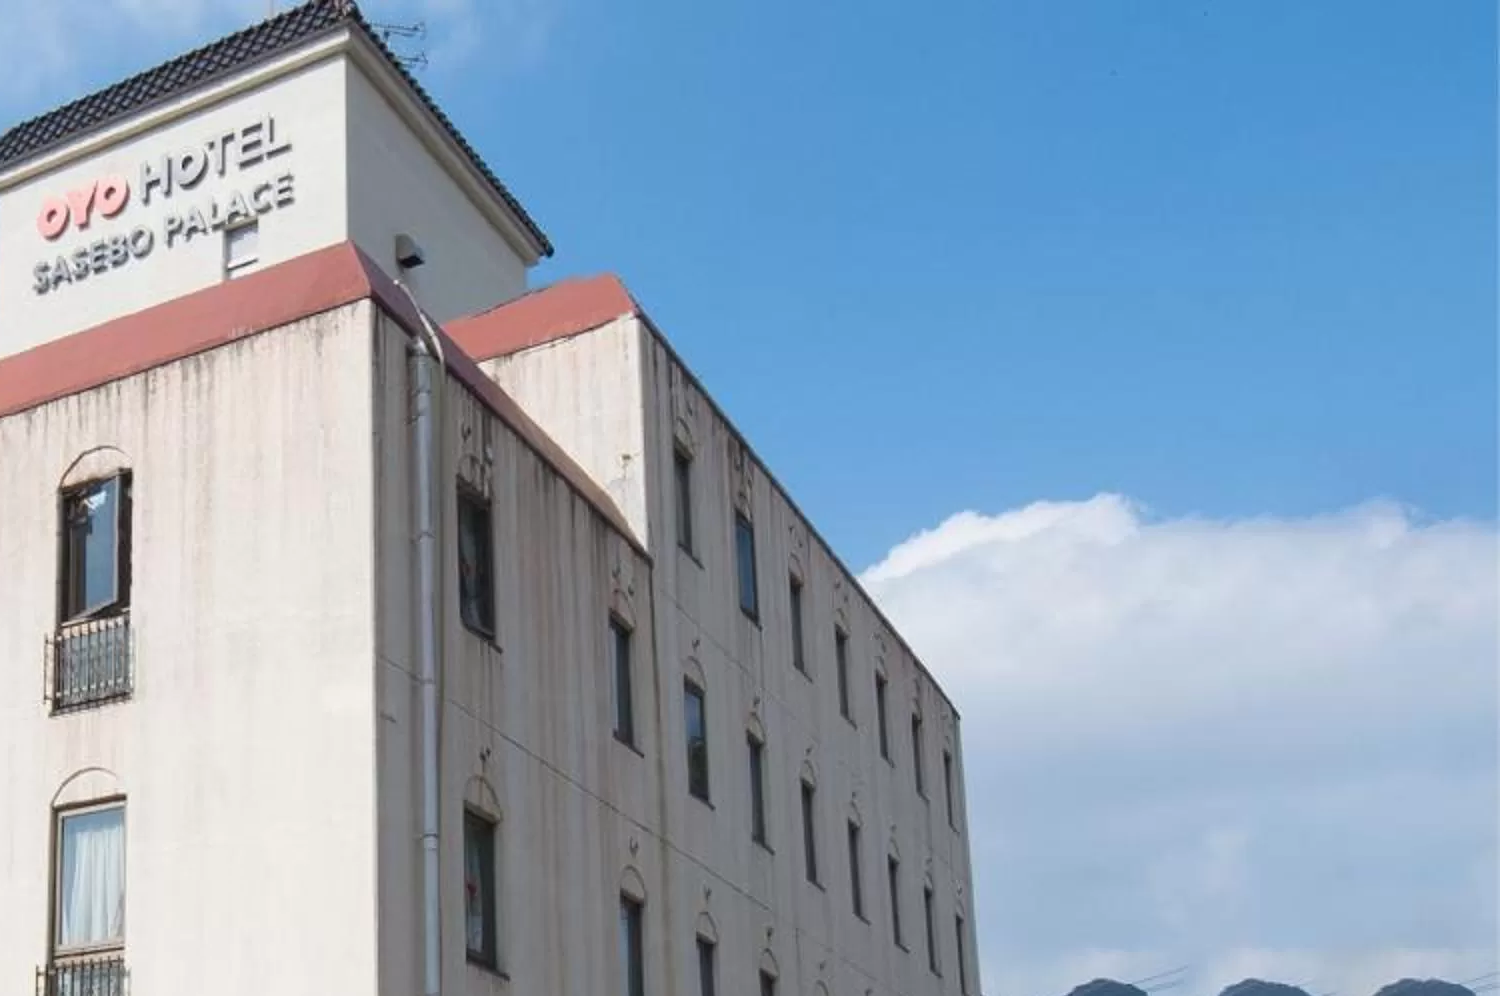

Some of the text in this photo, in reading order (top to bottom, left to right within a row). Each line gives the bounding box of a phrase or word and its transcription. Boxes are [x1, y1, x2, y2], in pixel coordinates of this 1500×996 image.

[32, 172, 295, 295] SASEBO PALACE
[36, 113, 292, 241] OYO HOTEL
